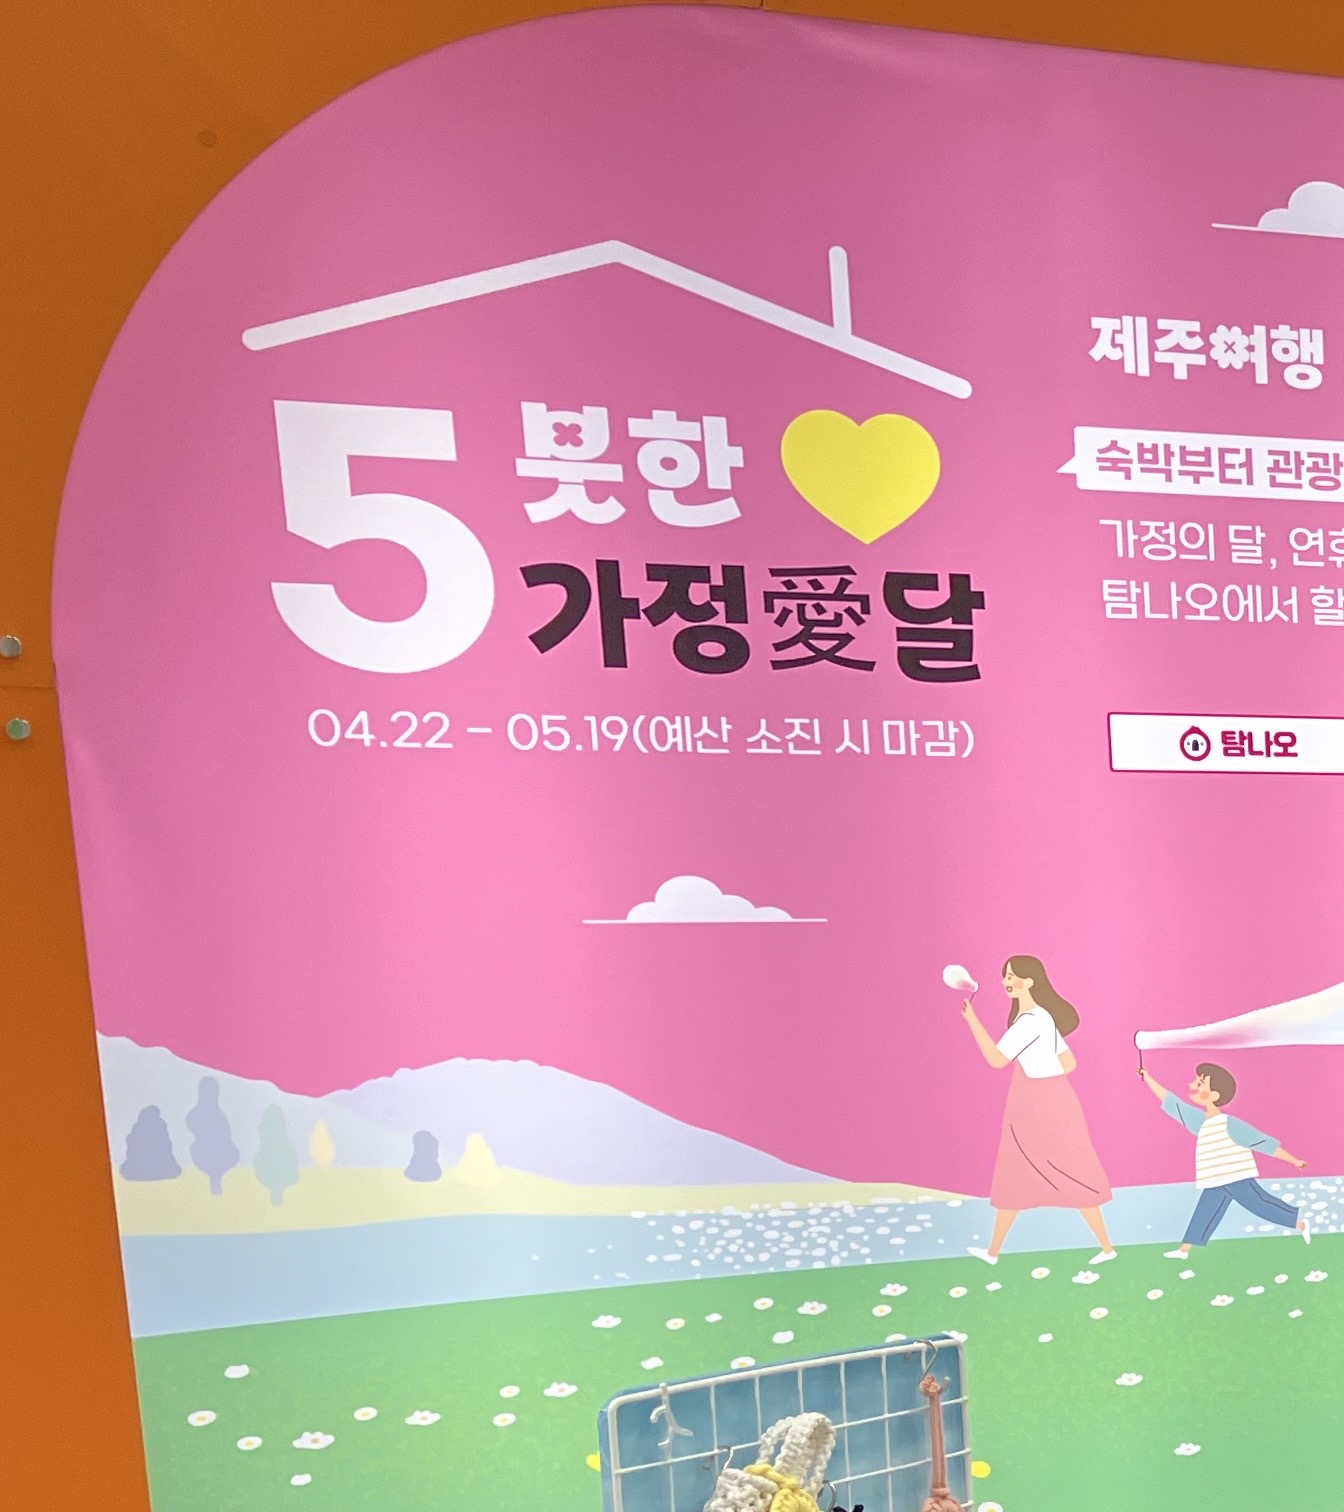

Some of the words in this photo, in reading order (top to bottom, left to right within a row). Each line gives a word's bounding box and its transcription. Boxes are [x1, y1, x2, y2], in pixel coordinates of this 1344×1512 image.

[1089, 315, 1325, 390] 제주여행
[1095, 440, 1254, 487] 숙박부터
[1099, 519, 1215, 562] 가정의
[1229, 522, 1278, 569] 달,
[519, 559, 985, 682] 가정愛달
[1101, 579, 1298, 625] 탐나오에서
[307, 708, 454, 750] 04.22
[506, 712, 730, 756] 05.19(예산
[746, 716, 822, 757] 소진
[834, 717, 869, 757] 시
[884, 718, 975, 759] 마감)
[1220, 728, 1299, 759] 탐나오
